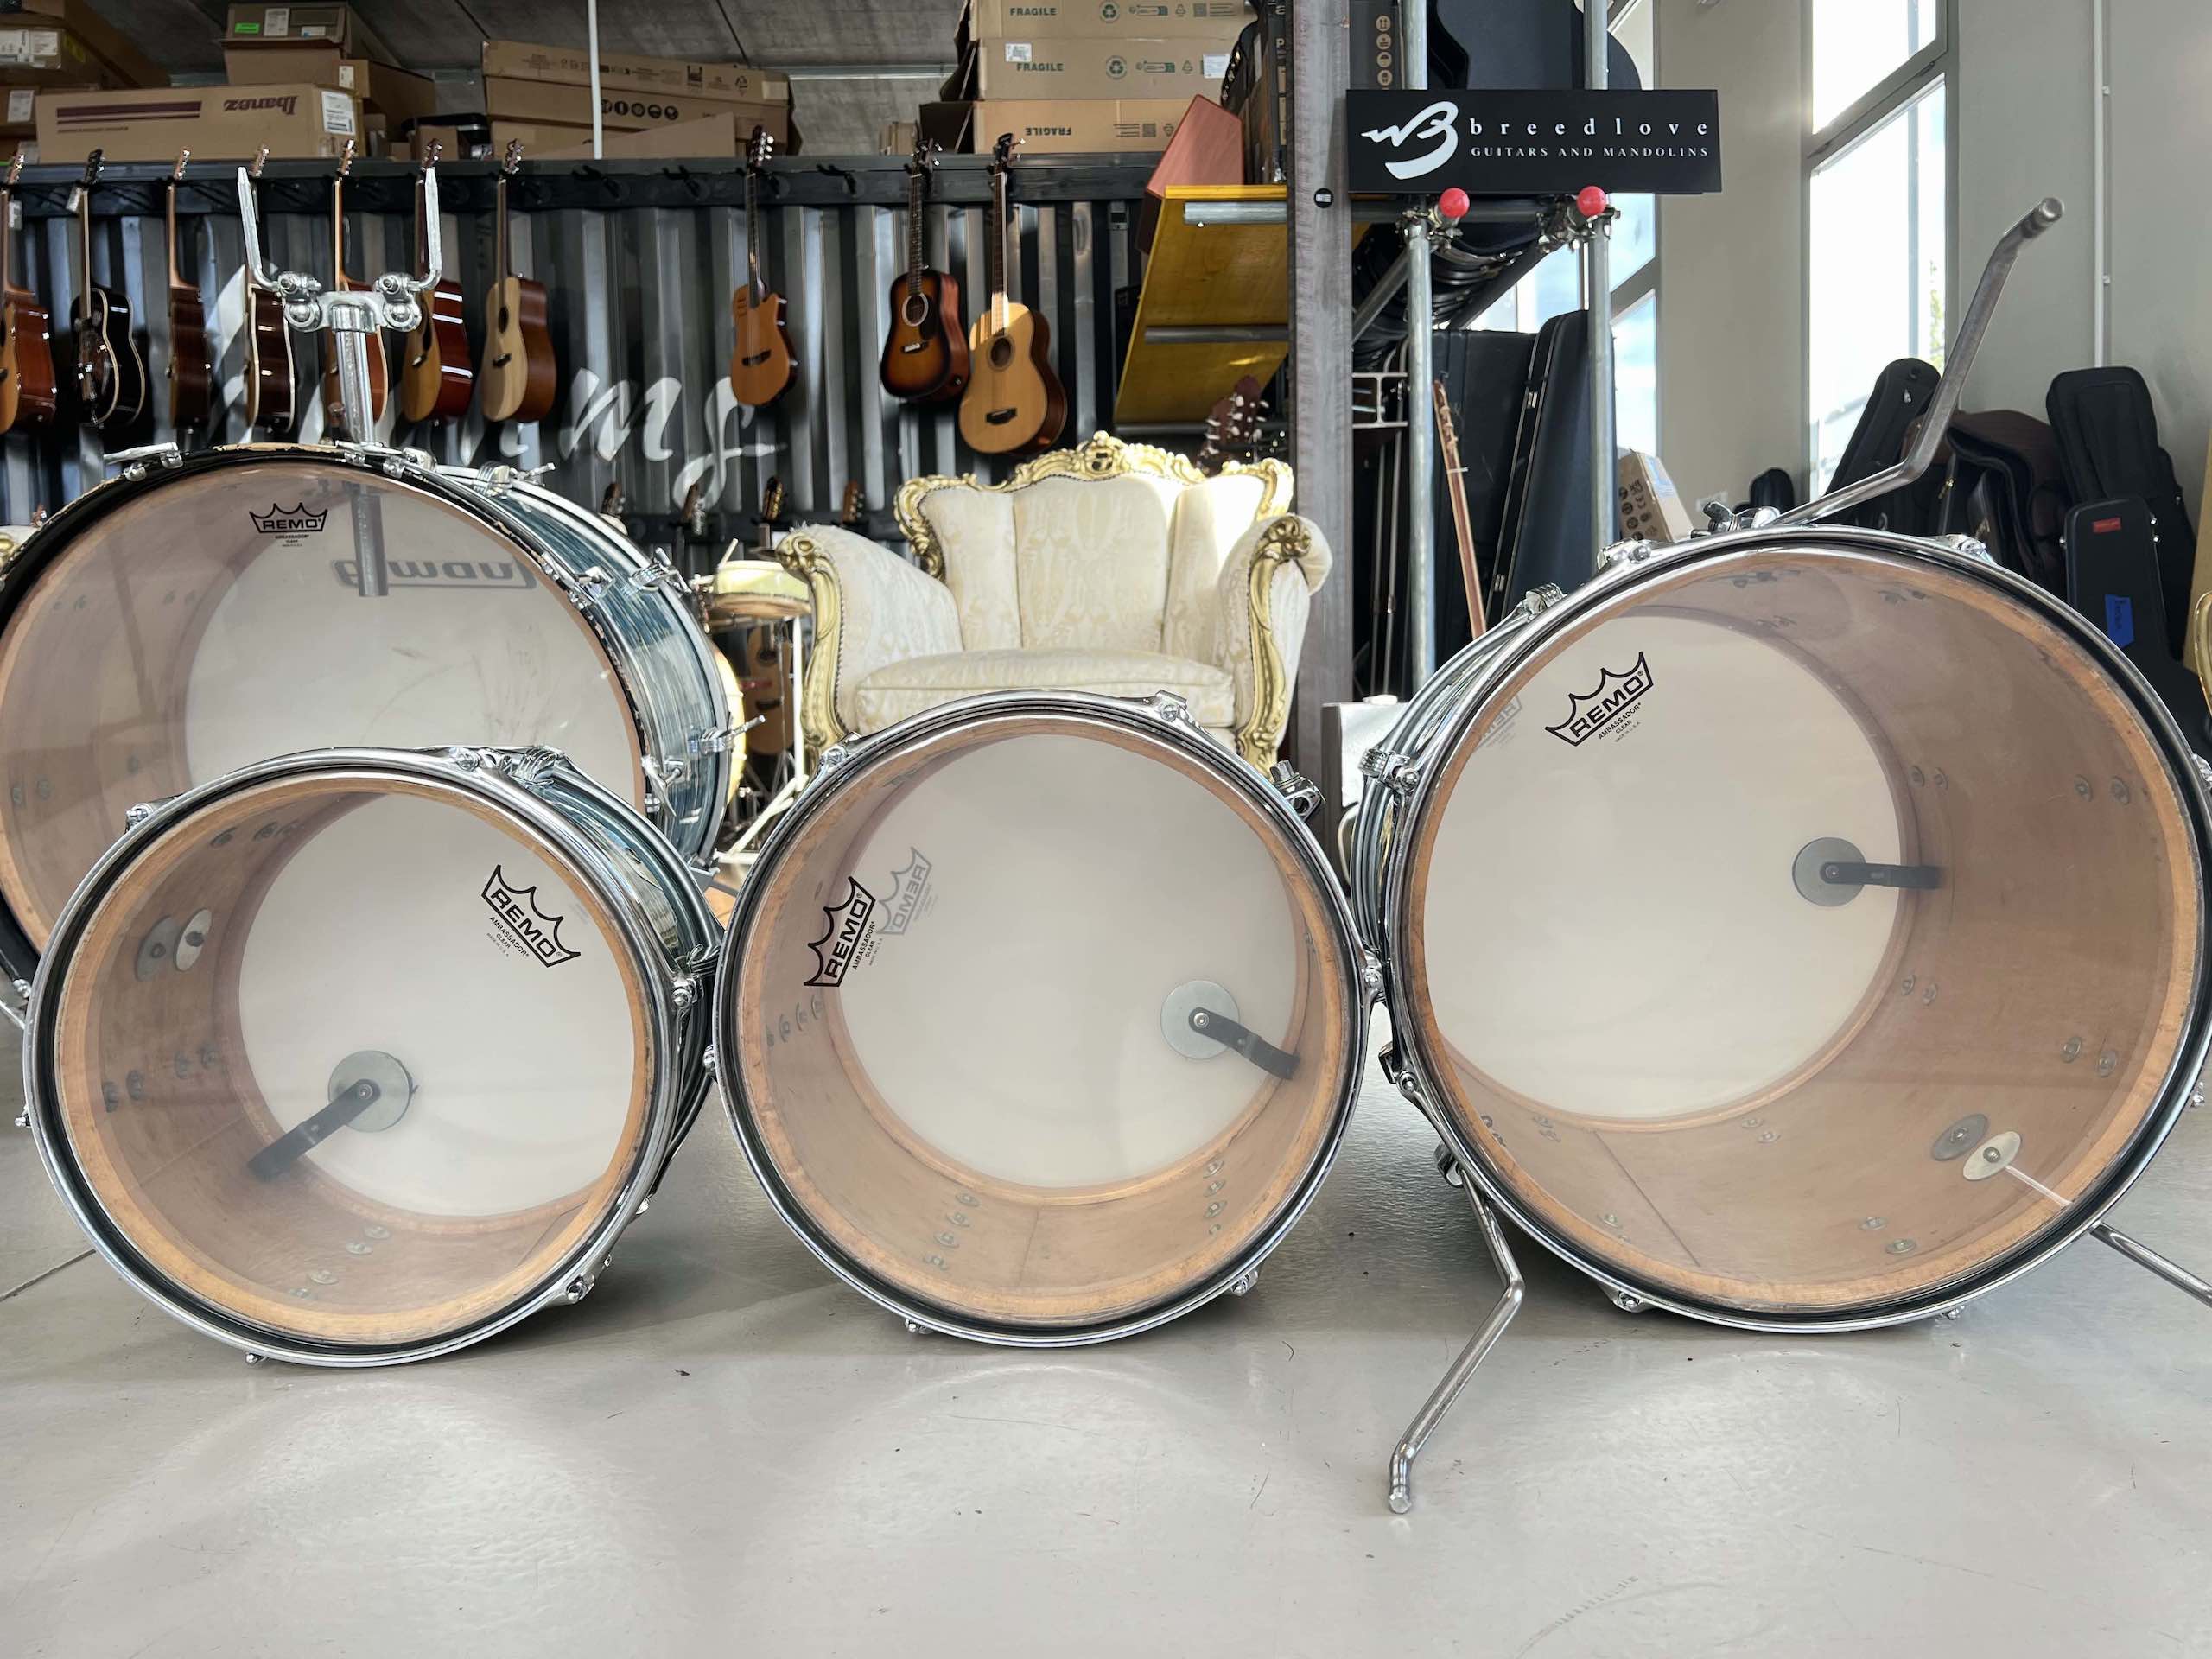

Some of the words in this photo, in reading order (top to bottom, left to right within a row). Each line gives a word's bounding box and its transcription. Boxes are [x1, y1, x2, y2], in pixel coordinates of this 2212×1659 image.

[1009, 7, 1058, 16] FRAGILE
[1016, 62, 1065, 72] FRAGILE
[223, 95, 299, 115] Ibanez
[1025, 126, 1072, 137] FRAGILE
[1470, 118, 1708, 136] breedlove
[1471, 147, 1548, 157] GUITARS
[1558, 147, 1593, 157] AND
[1603, 147, 1708, 157] MANDOLINS
[1615, 720, 1631, 734] CLEAR
[496, 933, 512, 949] CLEAR
[865, 940, 875, 957] CLEAR
